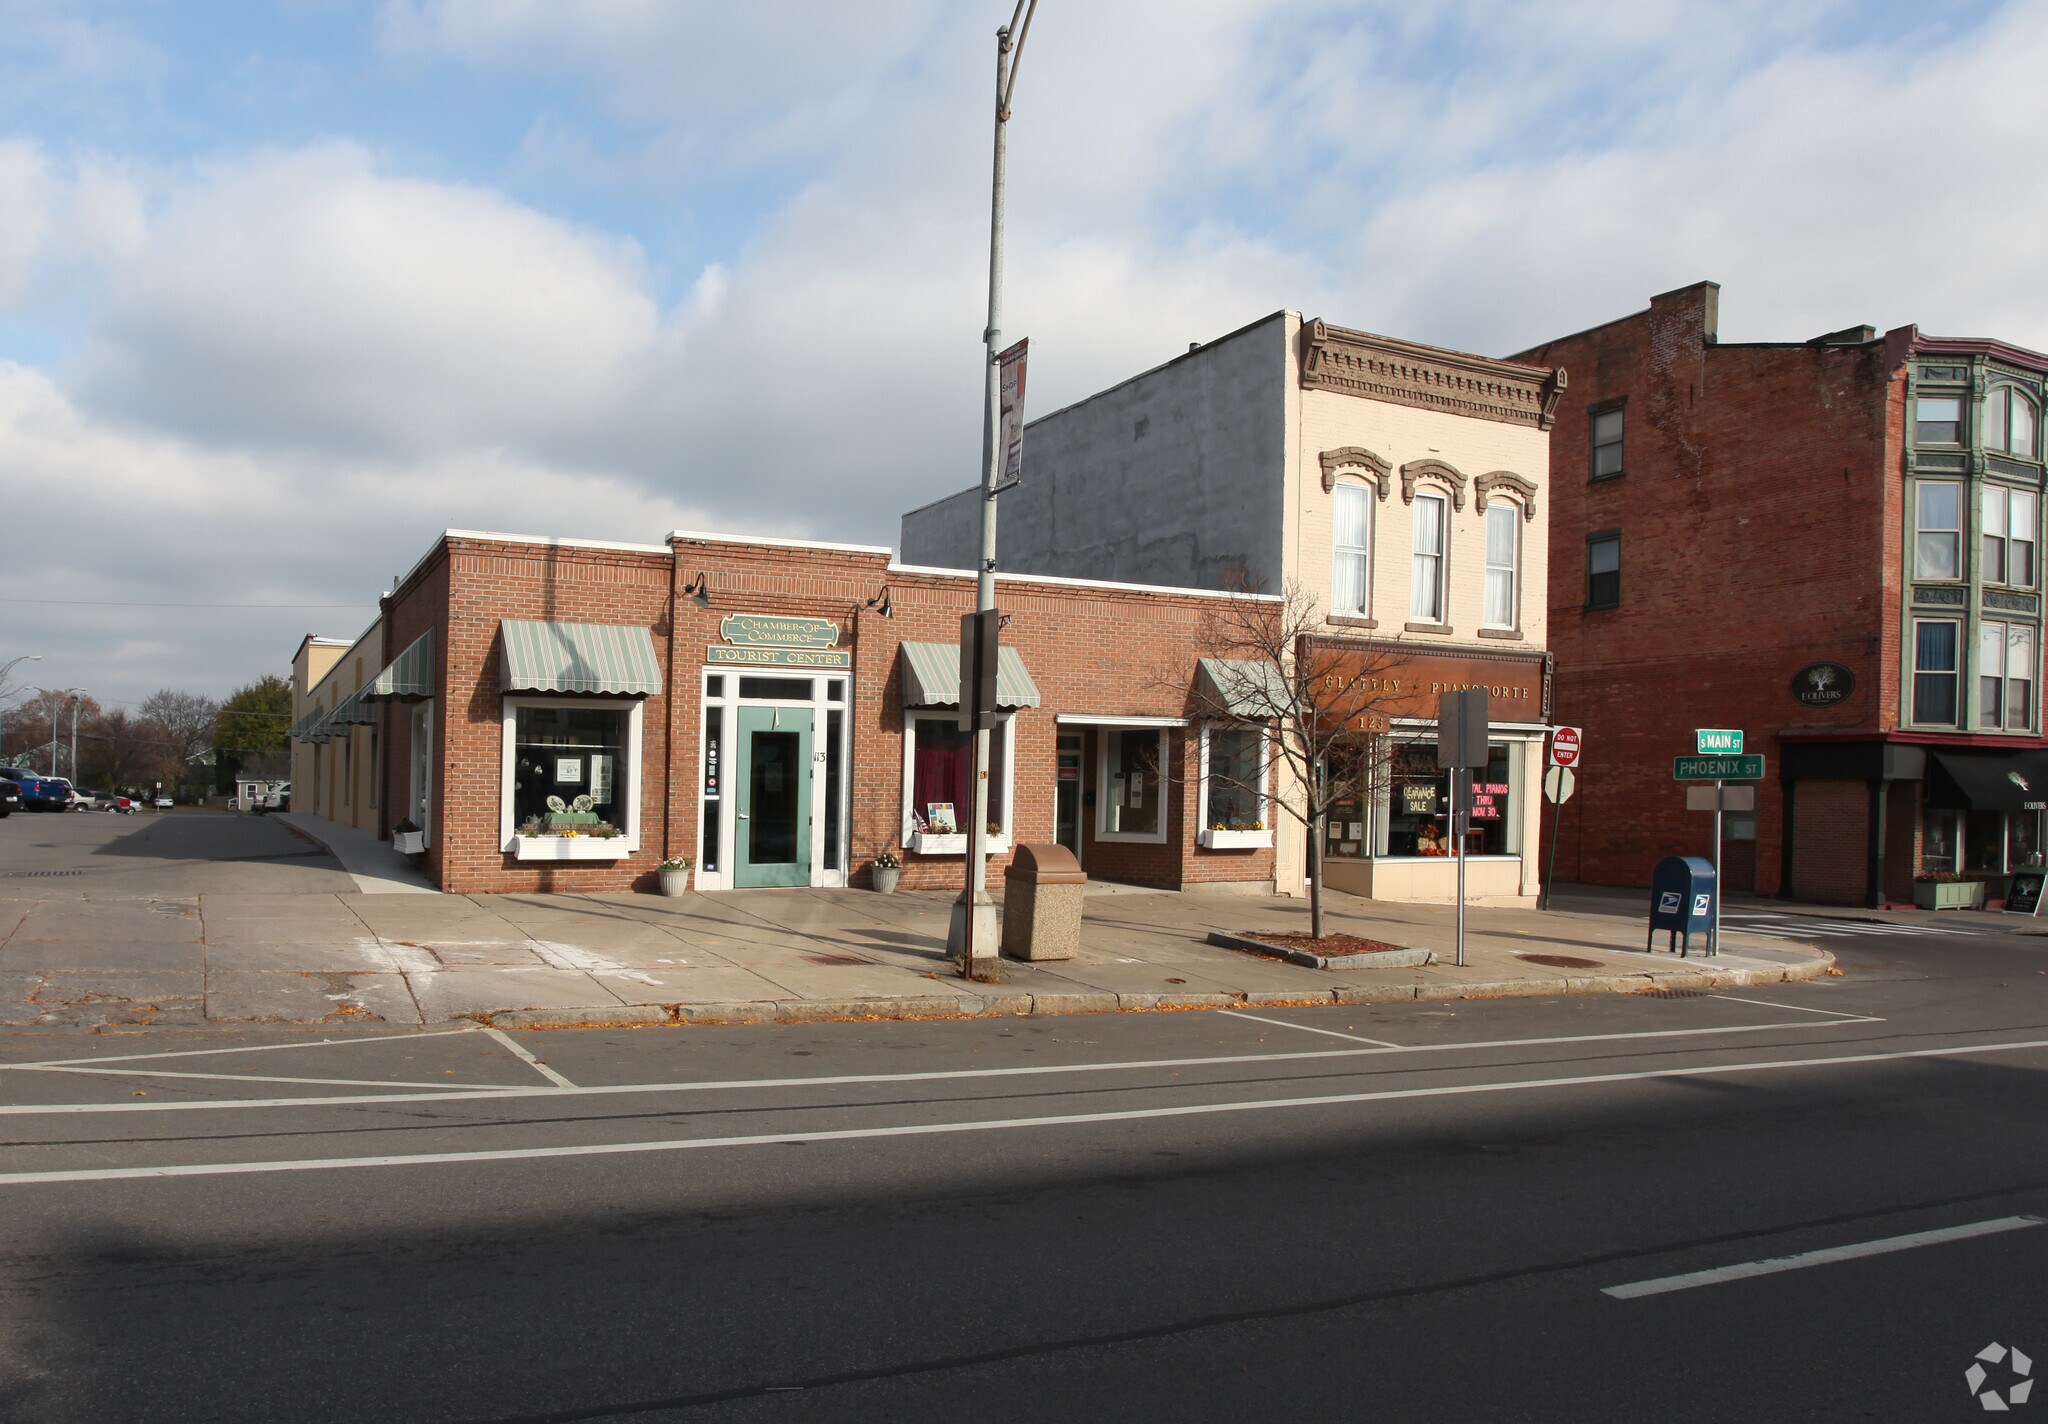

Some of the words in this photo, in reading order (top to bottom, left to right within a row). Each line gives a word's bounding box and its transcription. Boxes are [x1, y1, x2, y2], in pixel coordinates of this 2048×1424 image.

[748, 629, 813, 643] COMMERCE
[715, 649, 779, 662] TOURIST
[786, 652, 842, 665] CENTER
[1431, 682, 1529, 699] PIANORTE
[1359, 716, 1384, 729] 123
[1557, 733, 1565, 741] DO
[1700, 738, 1706, 748] S
[1707, 735, 1731, 748] MAIN
[1732, 739, 1740, 749] ST
[813, 752, 826, 762] 113
[1557, 751, 1573, 759] ENTER
[1680, 761, 1740, 775] PHOENIX
[1745, 764, 1757, 774] ST
[1403, 786, 1436, 800] CLEARANCE
[1485, 783, 1509, 794] PIANOS
[1476, 795, 1493, 805] THRU
[1410, 801, 1427, 812] SALE
[1487, 806, 1496, 817] 30
